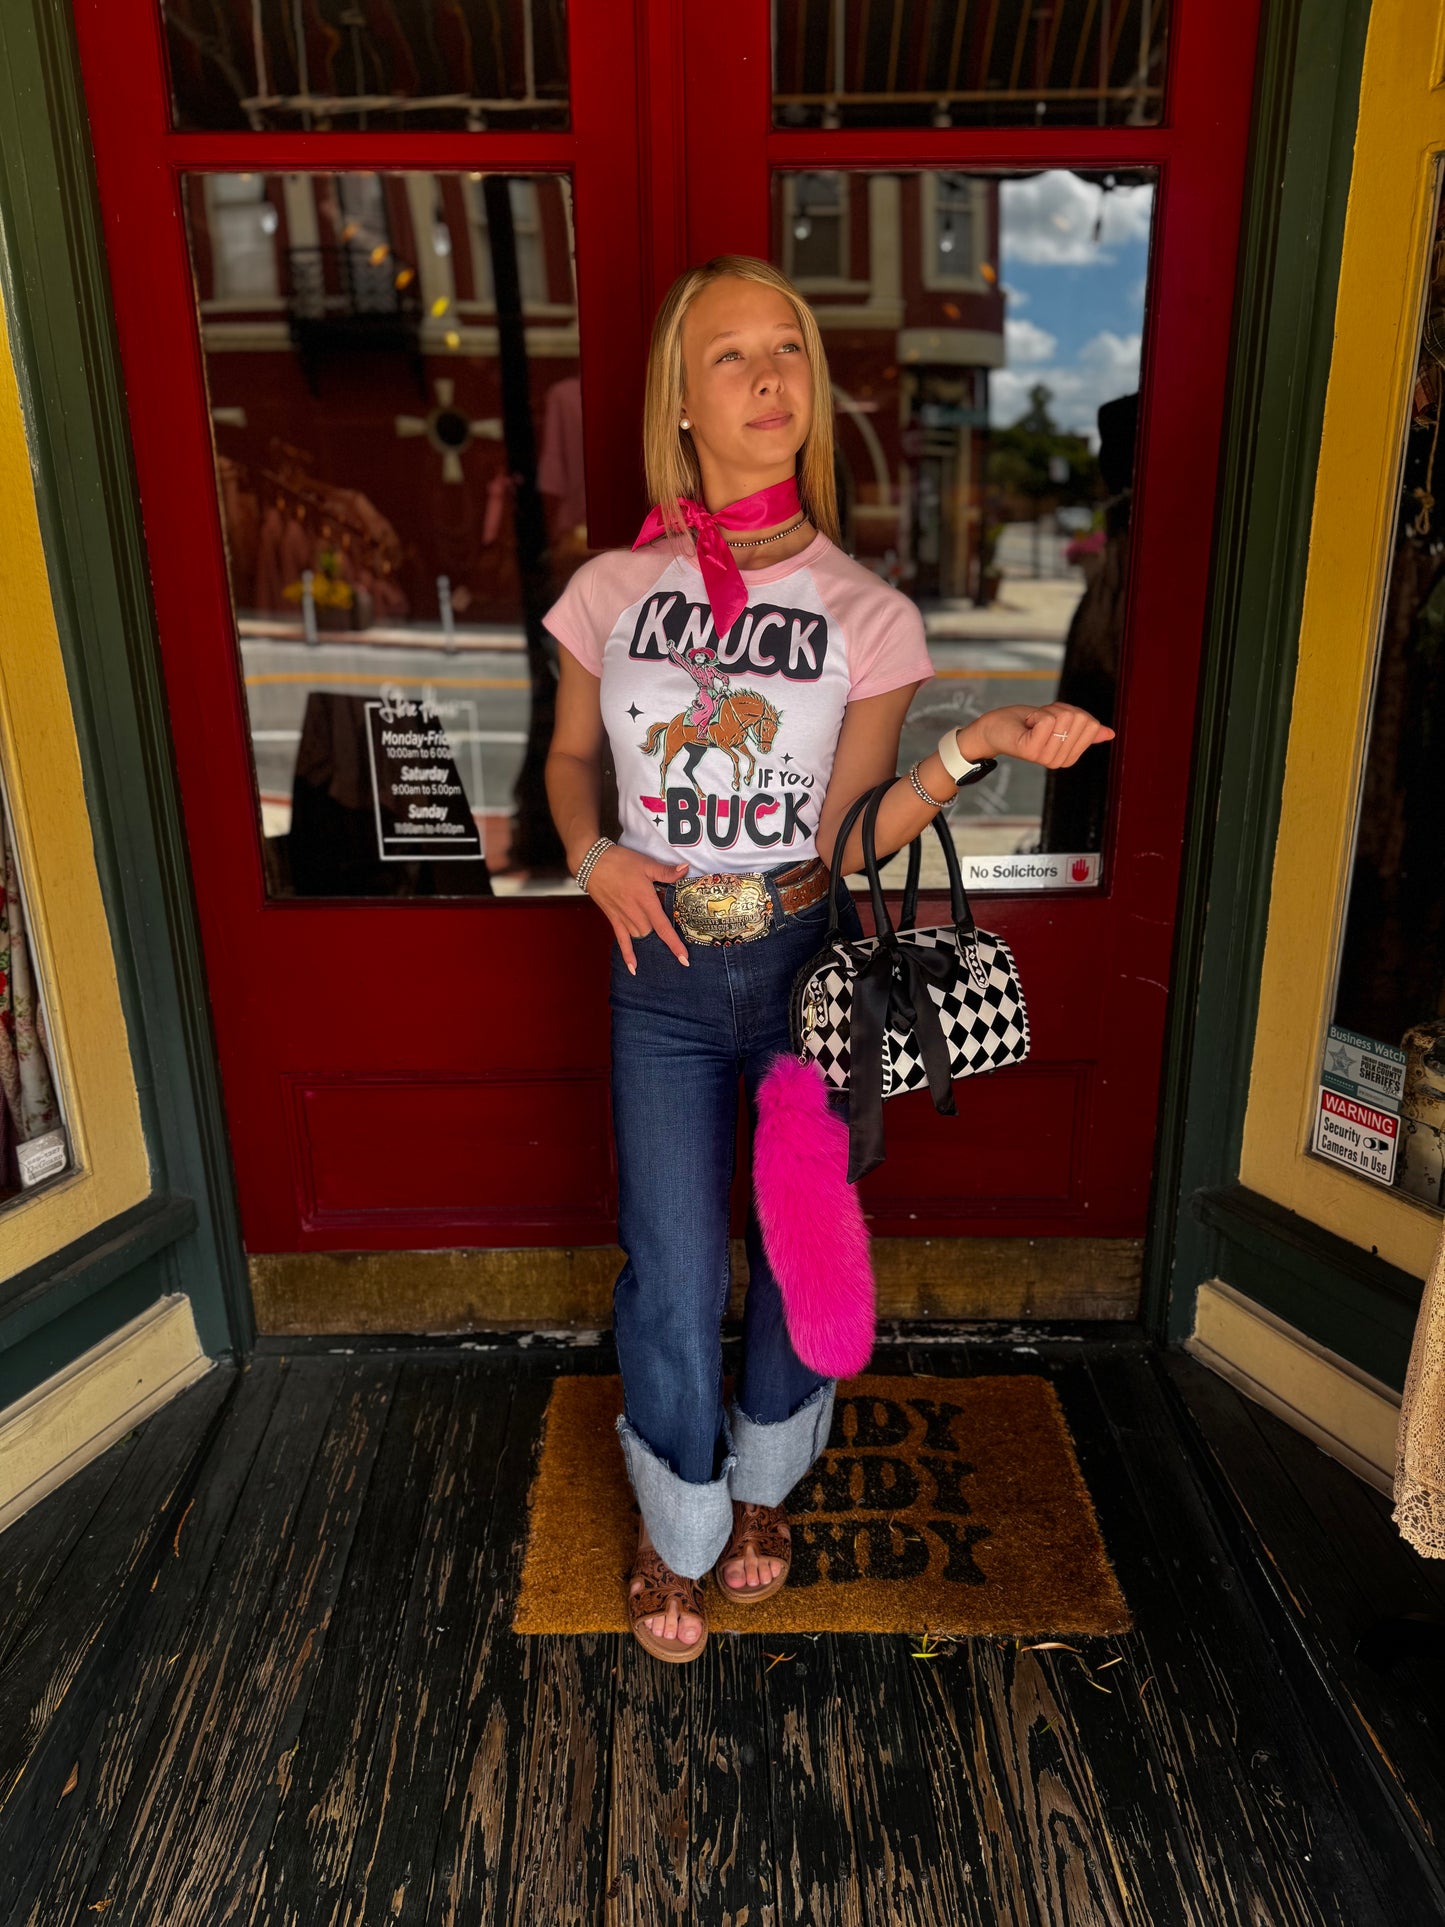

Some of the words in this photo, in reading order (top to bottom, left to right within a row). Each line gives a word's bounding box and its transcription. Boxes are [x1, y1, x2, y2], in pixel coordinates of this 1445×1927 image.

[635, 593, 820, 671] KNUCK
[420, 747, 429, 758] to
[400, 766, 449, 783] Saturday
[758, 768, 774, 788] IF
[779, 770, 815, 788] YOU
[422, 784, 431, 795] to
[408, 803, 448, 821] Sunday
[666, 787, 811, 849] BUCK
[970, 866, 988, 878] No
[992, 864, 1057, 878] Solicitors
[1330, 1026, 1371, 1051] Business
[1374, 1042, 1406, 1064] Watch
[1361, 1060, 1376, 1071] POLK
[1377, 1066, 1401, 1081] COUNTY
[1324, 1094, 1393, 1134] WARNING
[1323, 1117, 1361, 1147] Security
[1321, 1134, 1357, 1164] Cameras
[1360, 1151, 1368, 1167] In
[1371, 1155, 1387, 1175] Use
